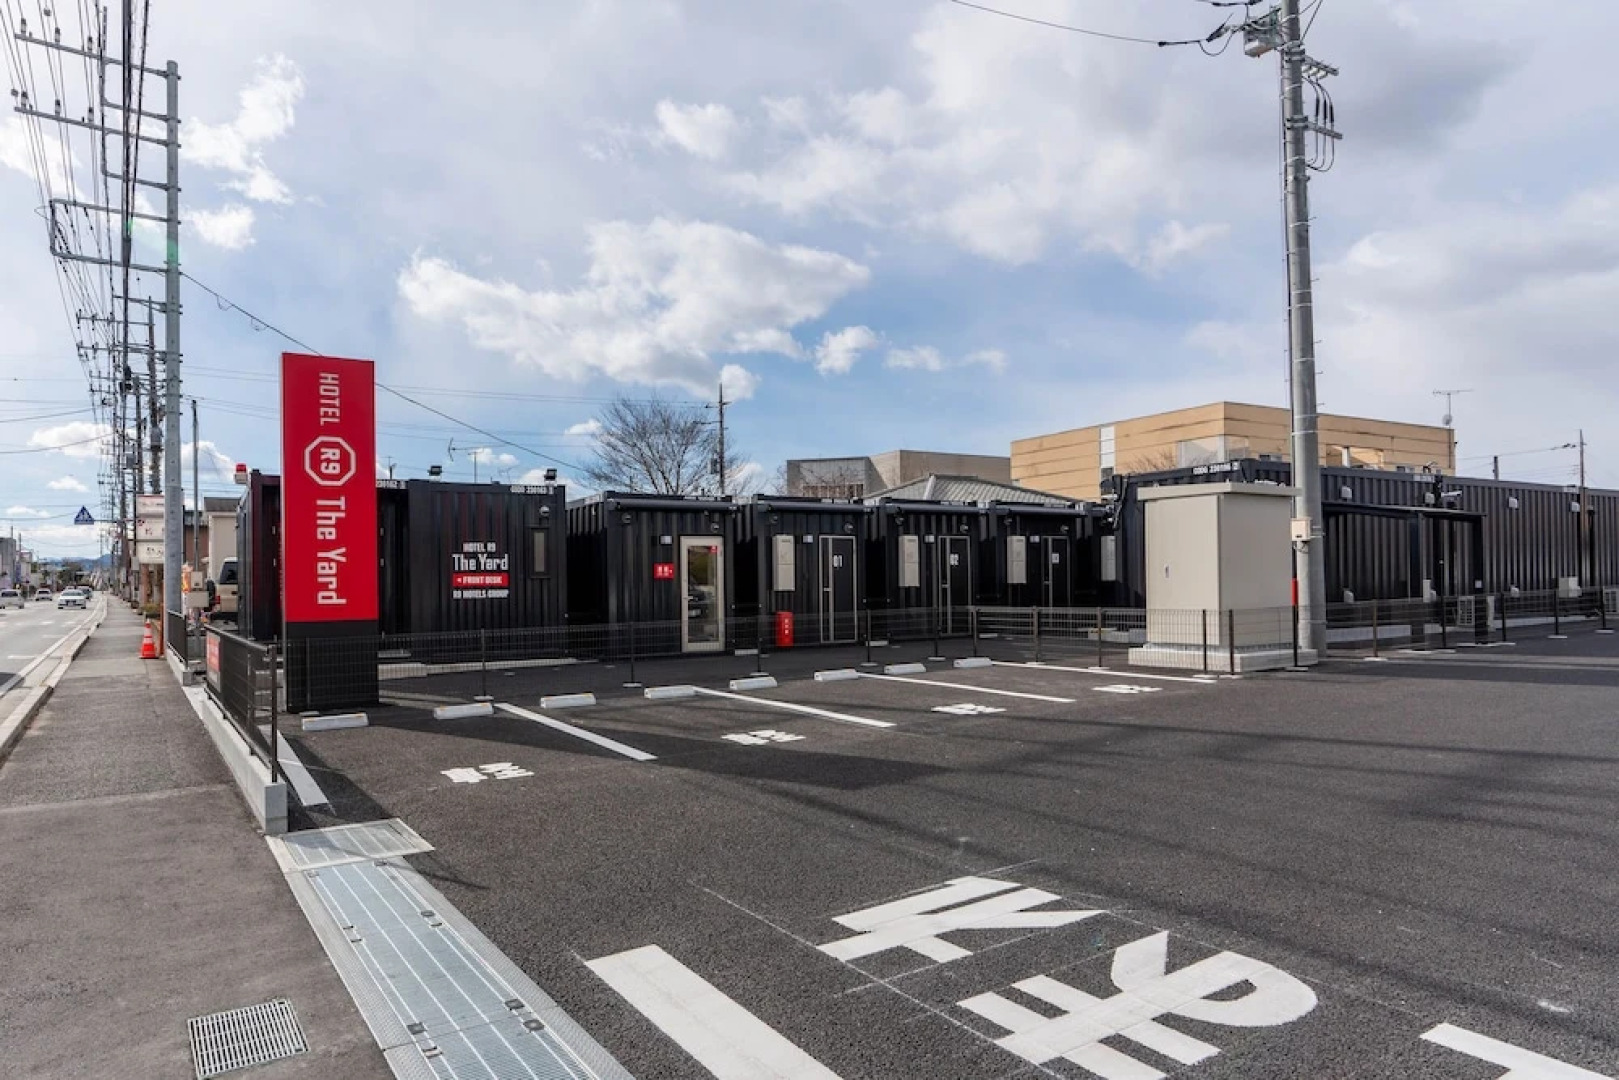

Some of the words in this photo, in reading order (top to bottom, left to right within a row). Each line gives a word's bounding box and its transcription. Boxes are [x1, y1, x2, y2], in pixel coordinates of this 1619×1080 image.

[319, 372, 341, 426] HOTEL
[320, 447, 341, 475] R9
[316, 496, 346, 540] The
[316, 546, 348, 605] Yard
[452, 553, 477, 571] The
[477, 553, 509, 571] Yard
